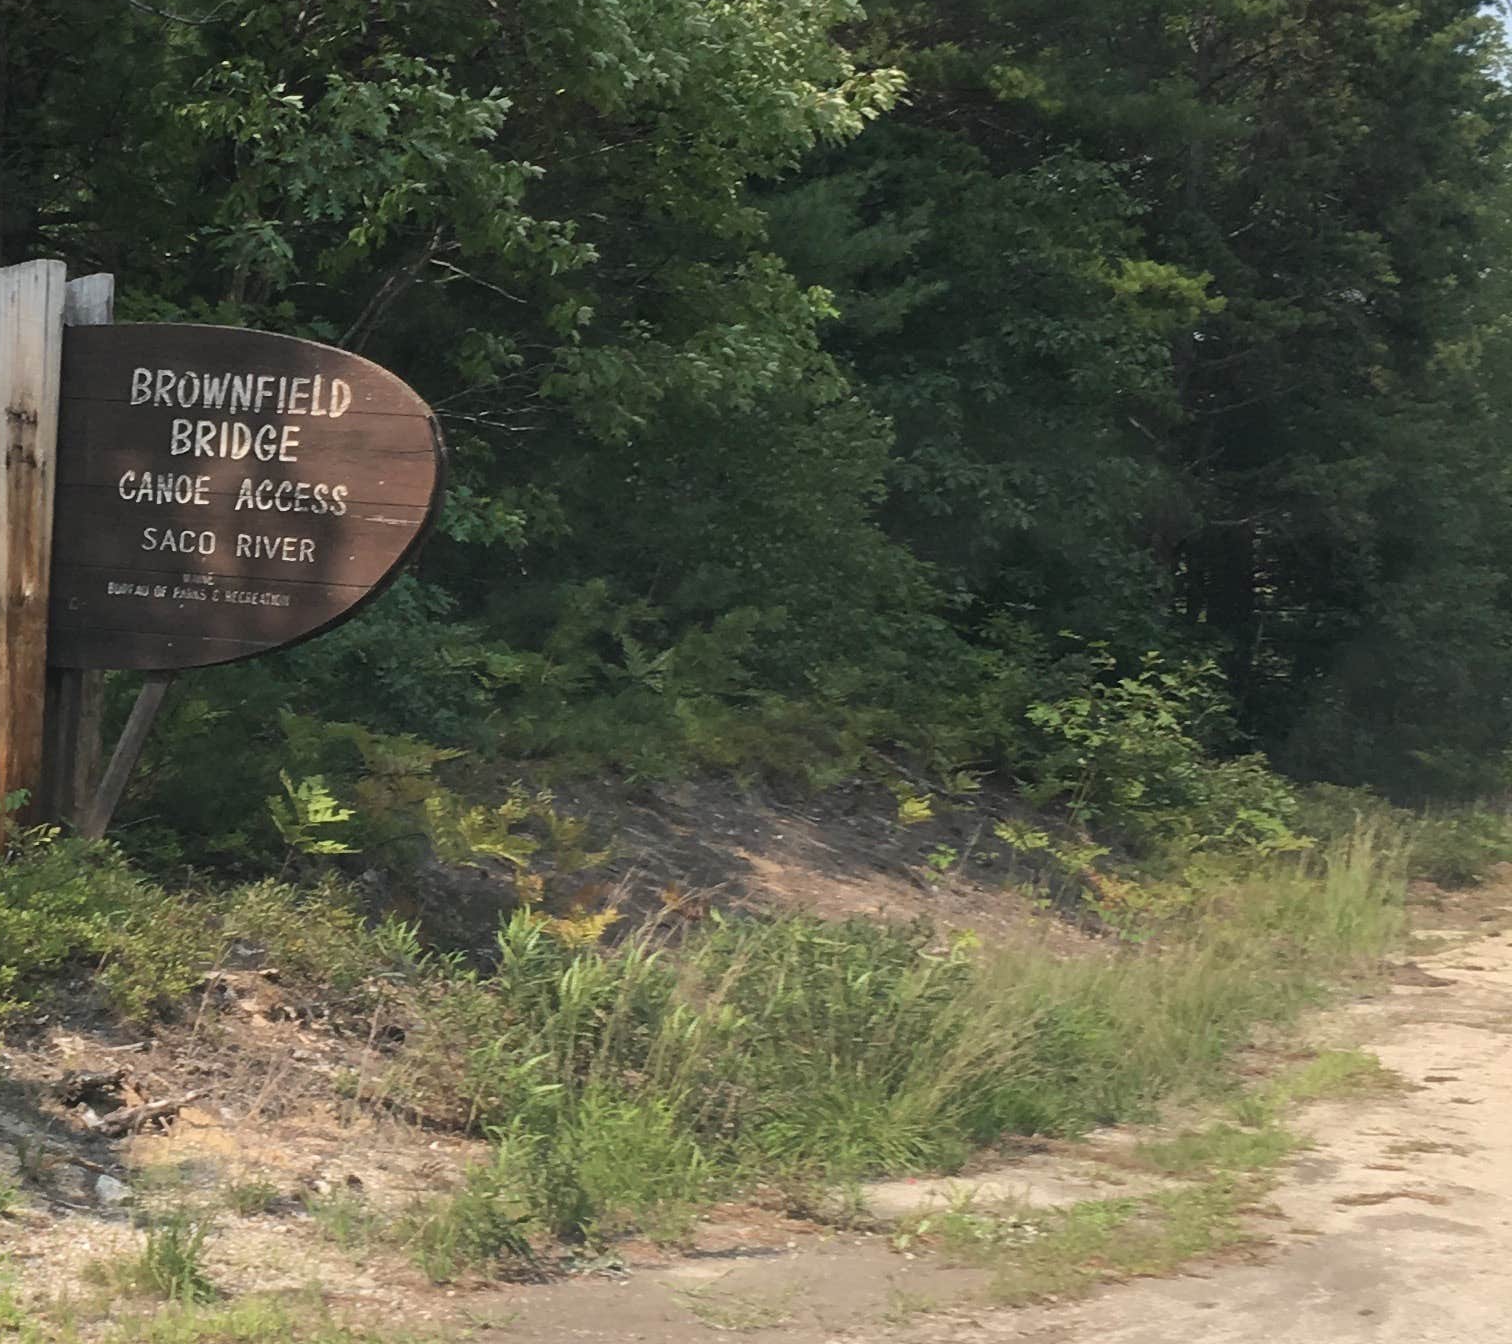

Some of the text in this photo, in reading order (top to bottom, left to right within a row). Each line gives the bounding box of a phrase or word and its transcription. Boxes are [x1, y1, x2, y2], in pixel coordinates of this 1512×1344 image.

[129, 367, 352, 419] BROWNFIELD
[170, 418, 301, 462] BRIDGE
[118, 470, 349, 516] CANOE ACCESS
[141, 527, 315, 563] SACO RIVER
[153, 584, 168, 598] OF
